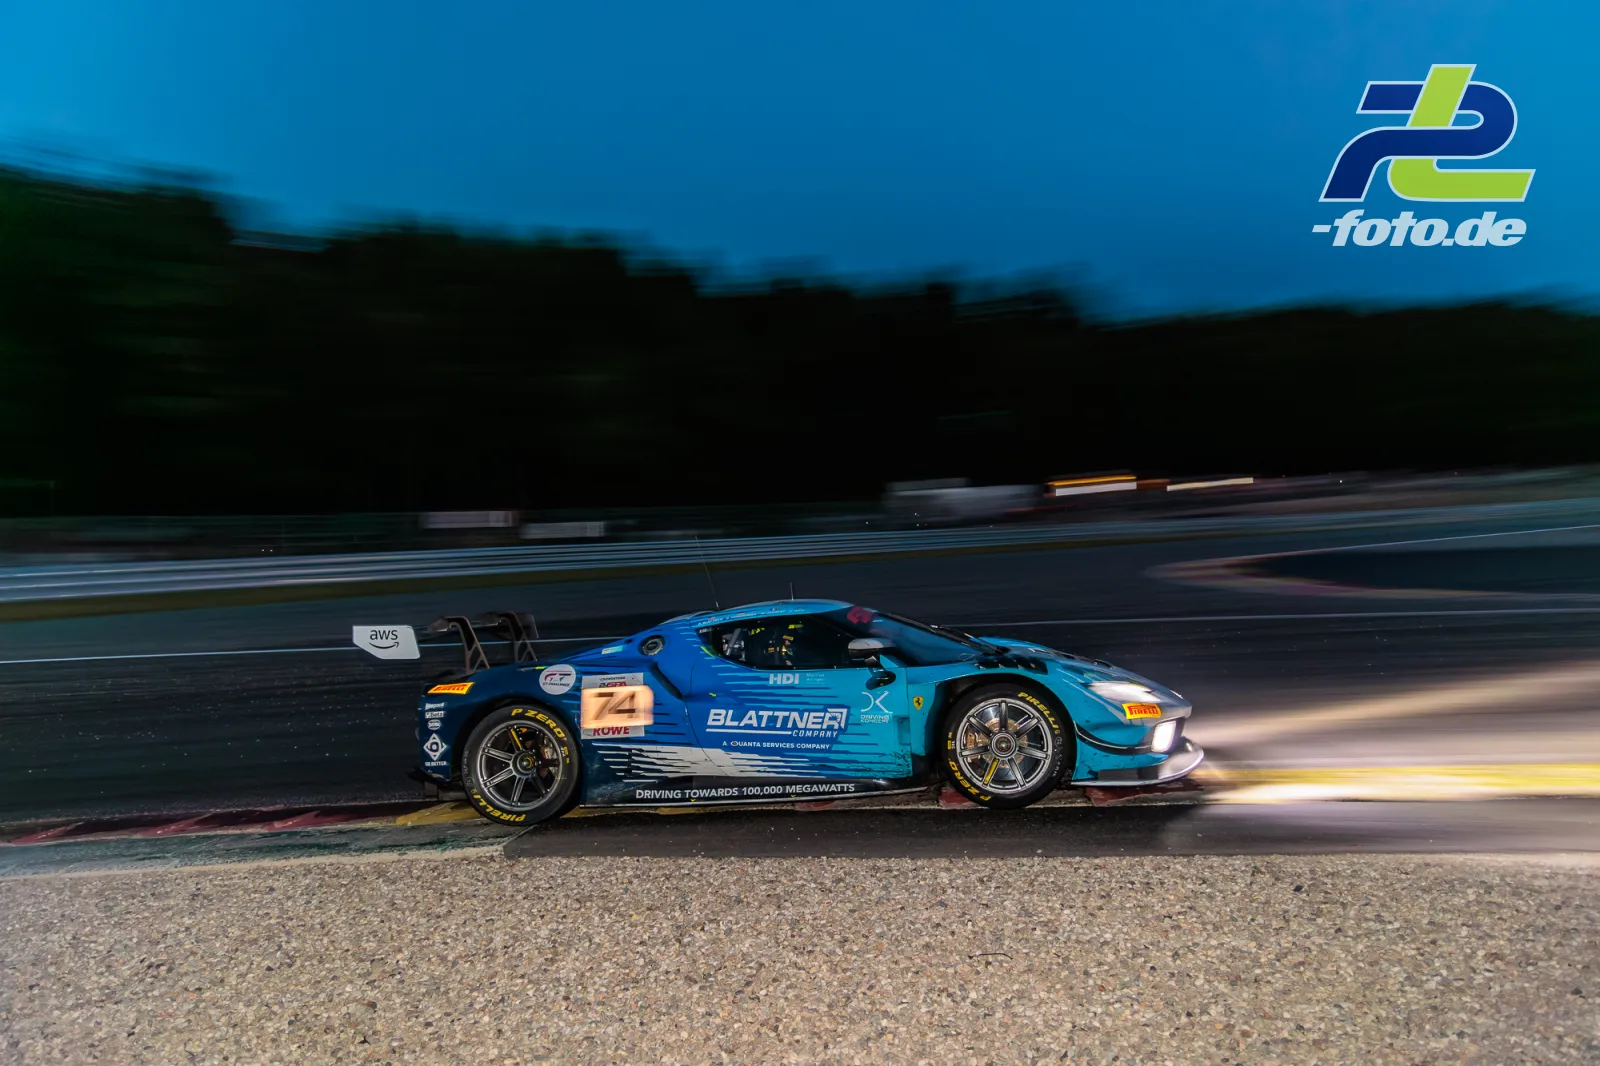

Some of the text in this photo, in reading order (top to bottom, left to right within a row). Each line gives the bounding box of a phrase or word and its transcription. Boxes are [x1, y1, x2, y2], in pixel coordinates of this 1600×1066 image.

[370, 629, 398, 641] aws
[769, 673, 800, 685] HDI
[588, 689, 636, 722] 74
[1017, 691, 1060, 730] PIRELLI
[1127, 705, 1159, 716] PIRELLI
[511, 708, 566, 739] P ZERO
[707, 708, 848, 730] BLATTNER
[593, 726, 630, 737] ROWE
[792, 729, 838, 738] COMPANY
[948, 760, 980, 795] ZERO
[635, 783, 855, 799] DRIVING TOWARDS 100,000 MEGAWATTS
[473, 794, 527, 822] PIRELLI
